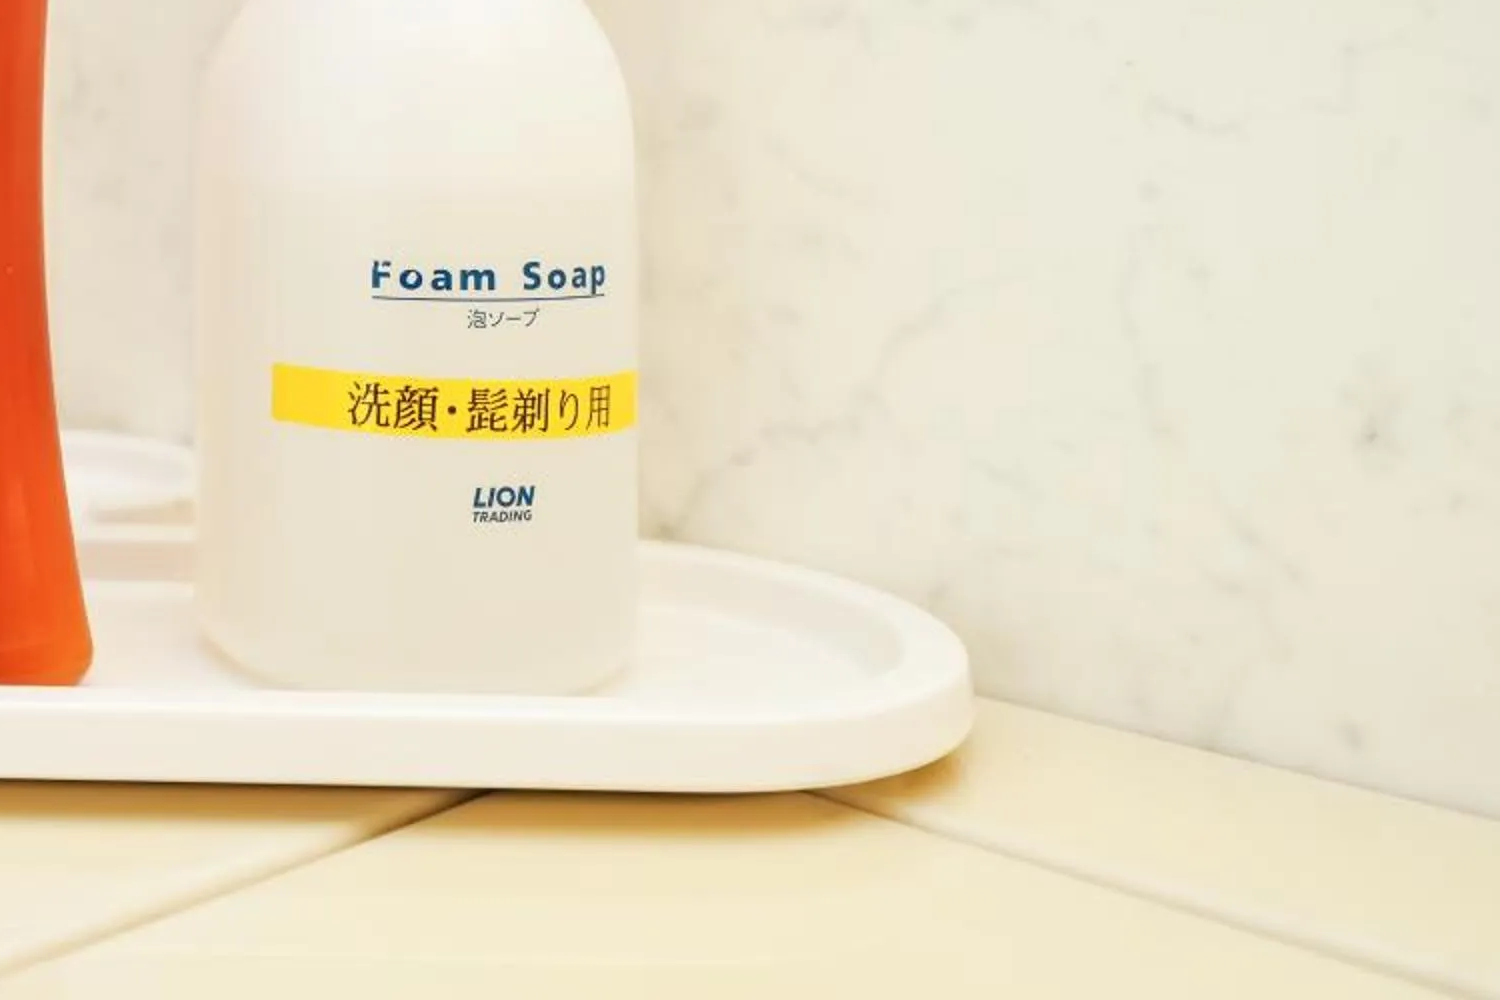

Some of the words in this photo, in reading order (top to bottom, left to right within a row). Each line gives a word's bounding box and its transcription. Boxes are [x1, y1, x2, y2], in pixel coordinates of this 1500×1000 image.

[372, 260, 496, 291] Foam
[522, 261, 606, 295] Soap
[467, 308, 541, 329] 泡ソープ
[346, 381, 612, 434] 洗顔・髭剃り用
[472, 485, 535, 508] LION
[472, 510, 533, 523] TRADING
